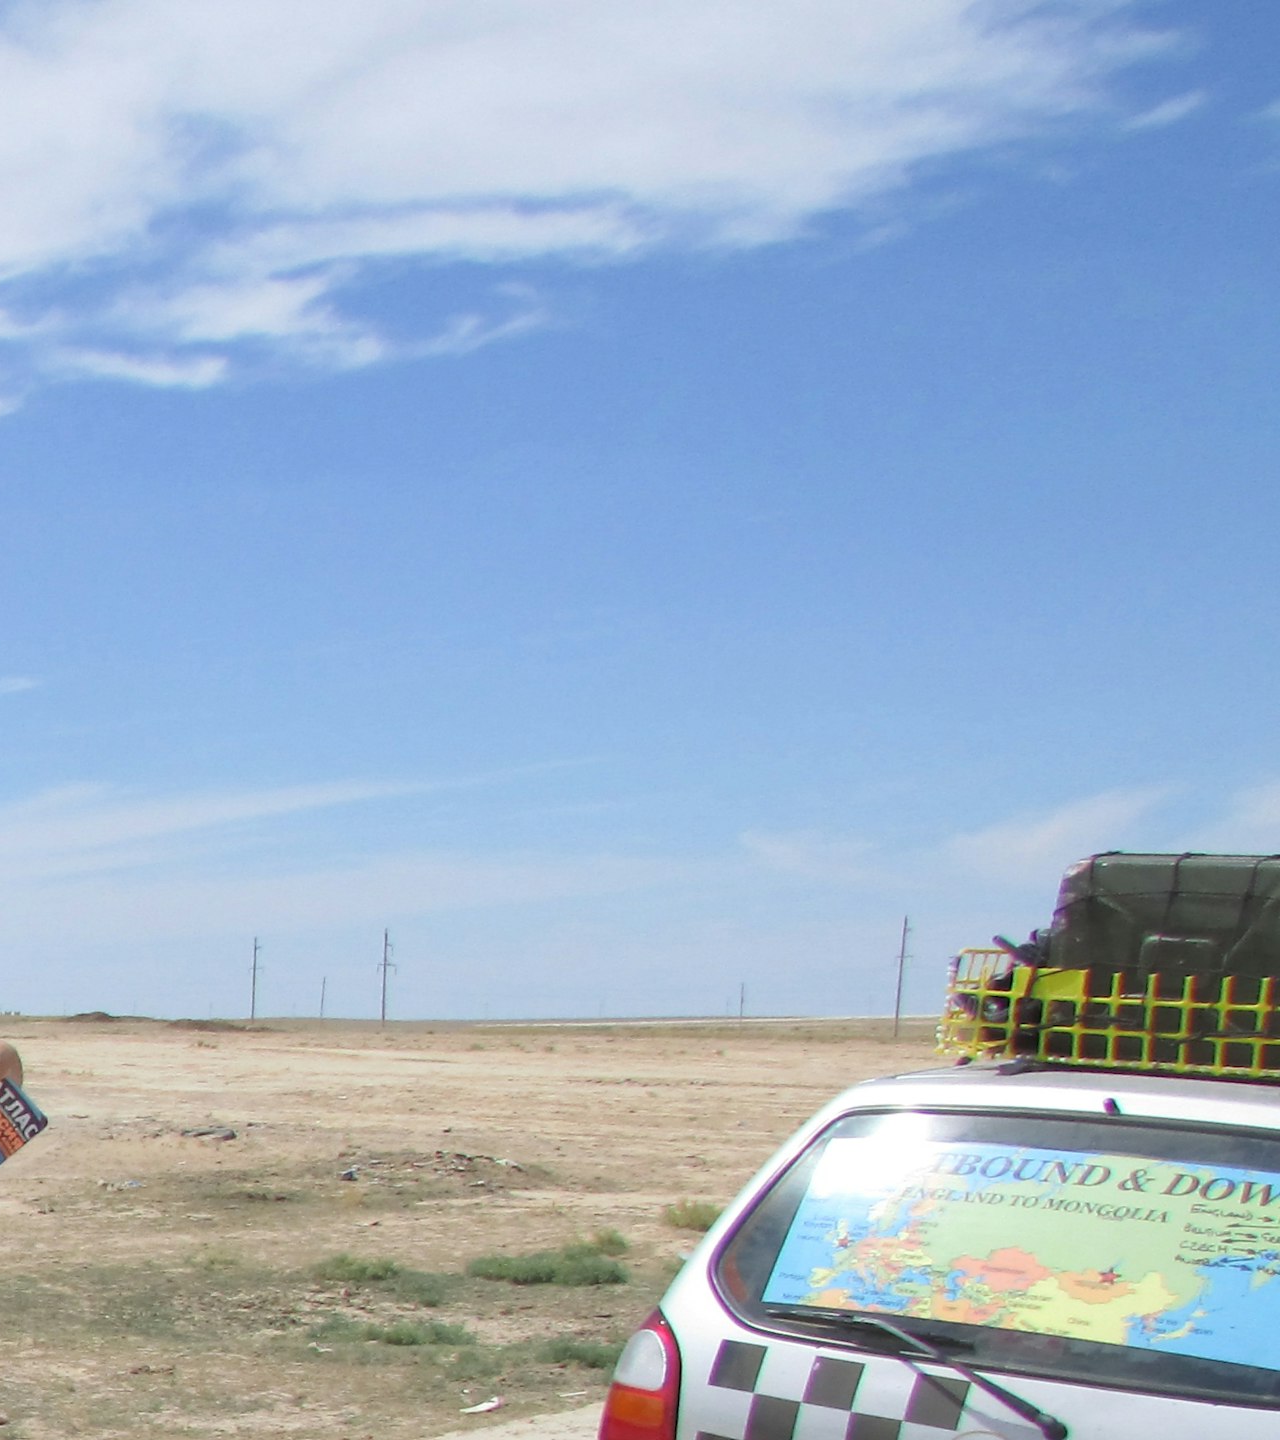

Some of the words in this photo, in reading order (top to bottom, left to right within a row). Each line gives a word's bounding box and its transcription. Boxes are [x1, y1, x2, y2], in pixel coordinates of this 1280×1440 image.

[926, 1152, 1112, 1188] TBOUND
[1118, 1168, 1155, 1193] &
[1010, 1194, 1040, 1210] TO
[1040, 1198, 1169, 1223] MONGOLIA
